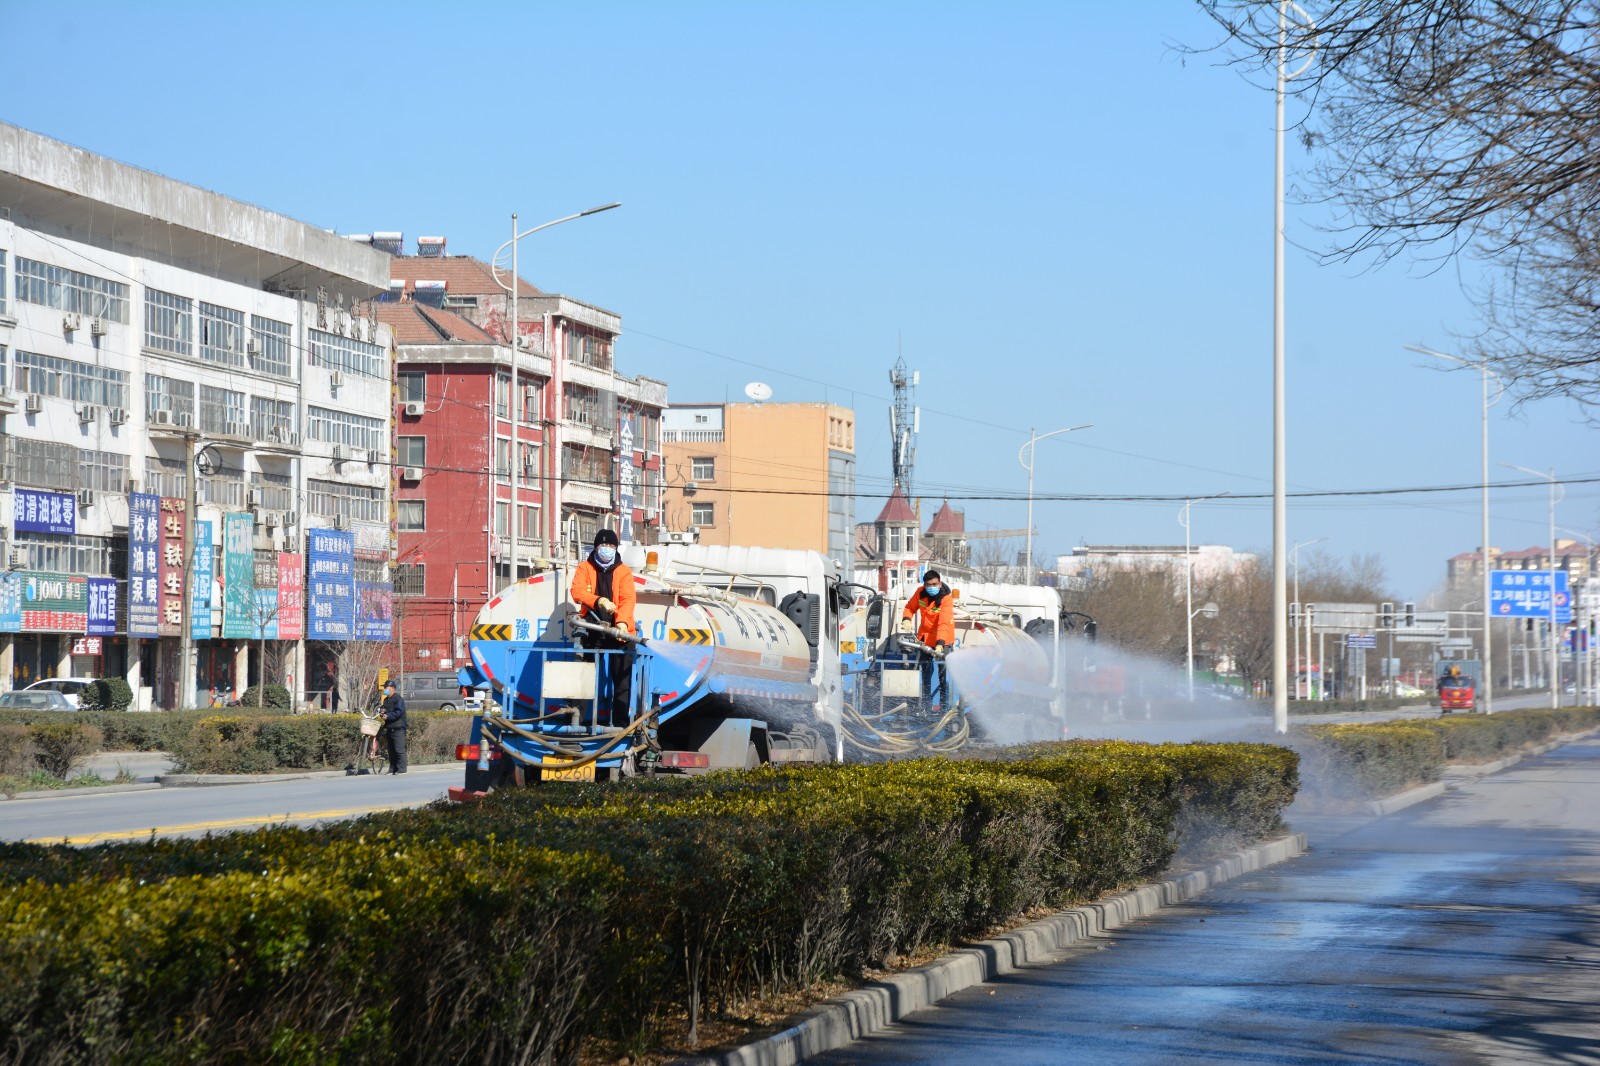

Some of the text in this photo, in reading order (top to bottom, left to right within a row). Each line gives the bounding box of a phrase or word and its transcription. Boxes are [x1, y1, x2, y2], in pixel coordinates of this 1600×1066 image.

[14, 493, 74, 526] 润滑油批零
[132, 514, 145, 603] 校油泵
[146, 516, 158, 604] 修电喷
[38, 581, 62, 601] JOMO
[89, 583, 117, 621] 液压管
